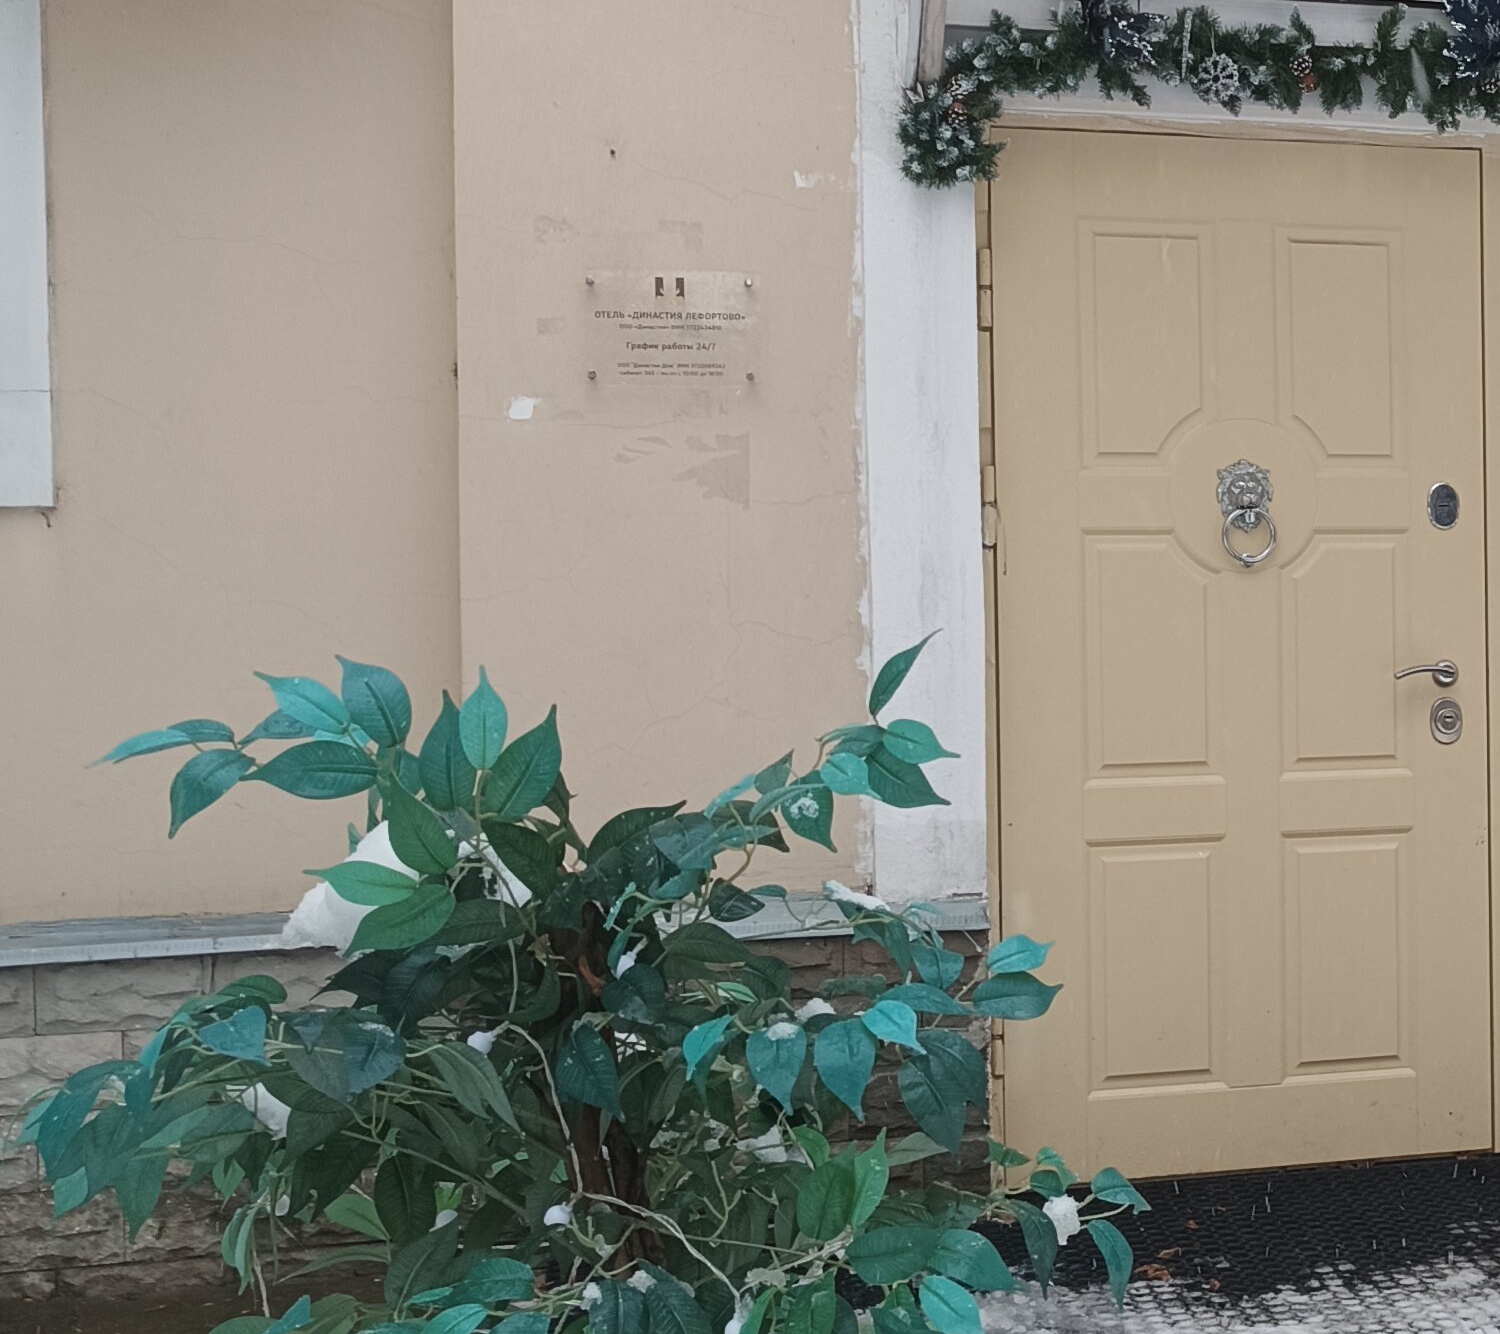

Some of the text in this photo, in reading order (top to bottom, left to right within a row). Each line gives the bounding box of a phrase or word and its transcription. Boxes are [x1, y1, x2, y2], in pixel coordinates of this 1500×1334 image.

[594, 310, 625, 319] ОТЕЛЬ
[626, 341, 717, 351] График работы 24/7
